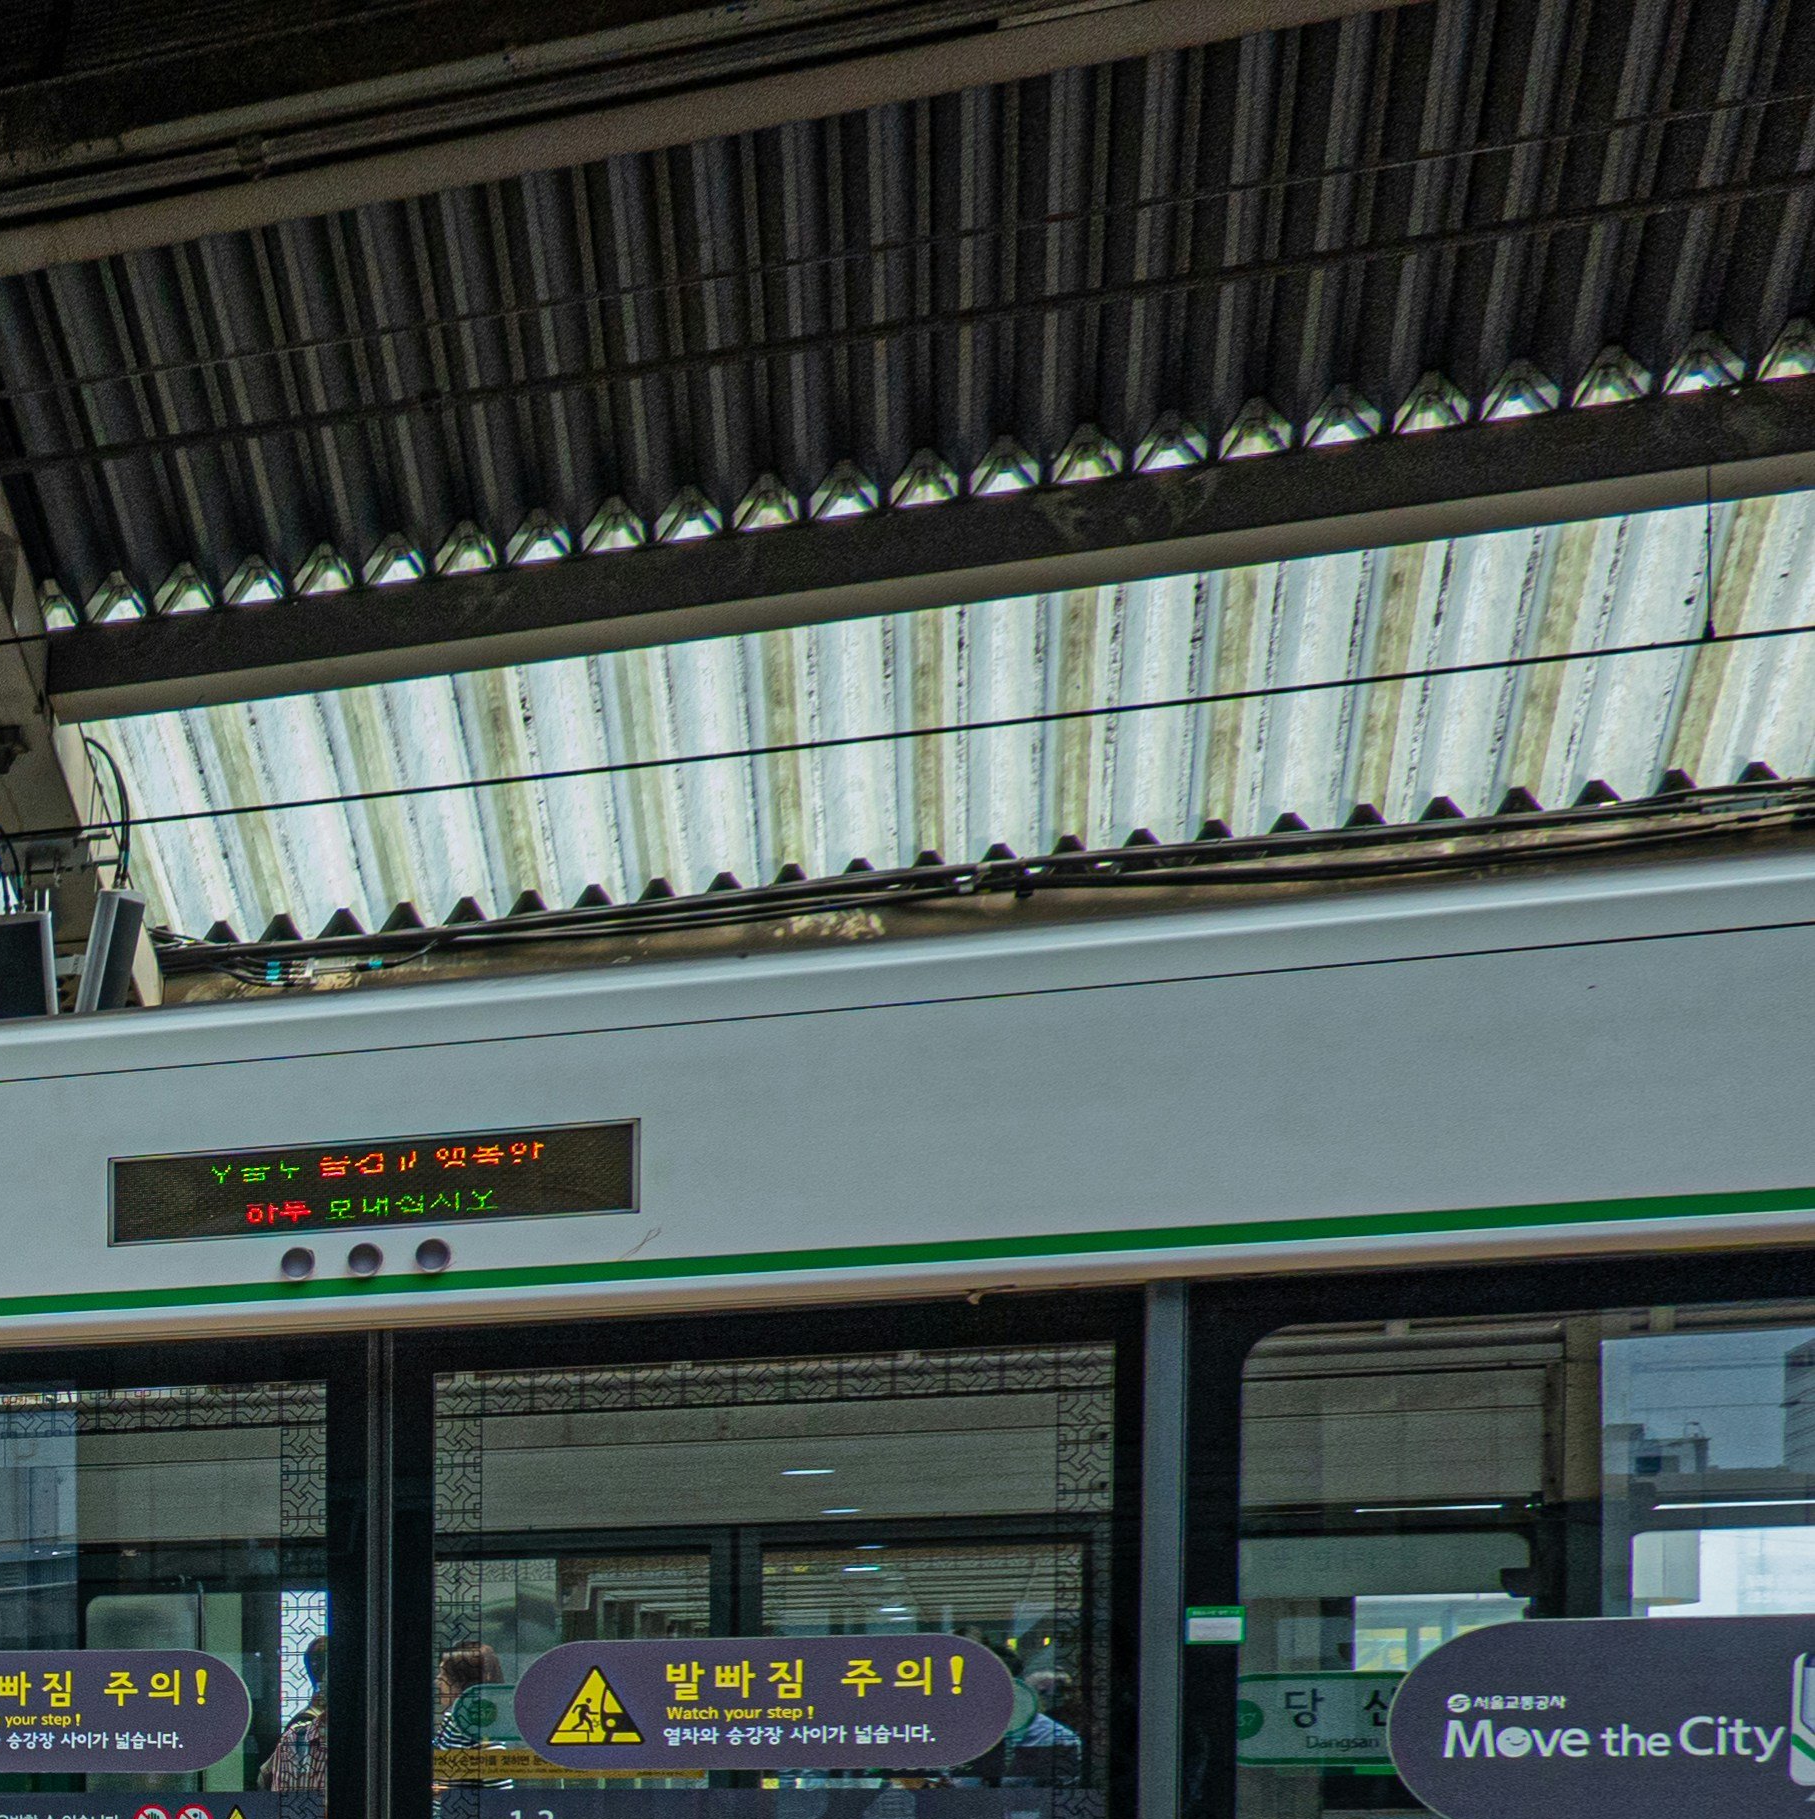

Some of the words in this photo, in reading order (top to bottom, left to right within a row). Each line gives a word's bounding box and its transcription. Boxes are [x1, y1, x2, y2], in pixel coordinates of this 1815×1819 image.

[103, 1669, 208, 1706] 주의!
[665, 1658, 804, 1701] 발빠짐
[840, 1655, 964, 1698] 주의!
[1473, 1695, 1567, 1710] 서울교통공사
[5, 1714, 37, 1728] your
[666, 1706, 719, 1720] Watch
[724, 1707, 762, 1722] your
[6, 1731, 55, 1750] 승강장
[60, 1731, 109, 1749] 사이가
[114, 1731, 184, 1750] 넓습니다.
[663, 1727, 720, 1746] 열차와
[726, 1726, 783, 1746] 승강장
[789, 1724, 848, 1744] 사이가
[854, 1724, 936, 1745] 넓습니다.
[1305, 1735, 1380, 1752] Dangsan
[1441, 1718, 1592, 1758] Move
[1599, 1723, 1672, 1757] the
[1678, 1715, 1786, 1762] City
